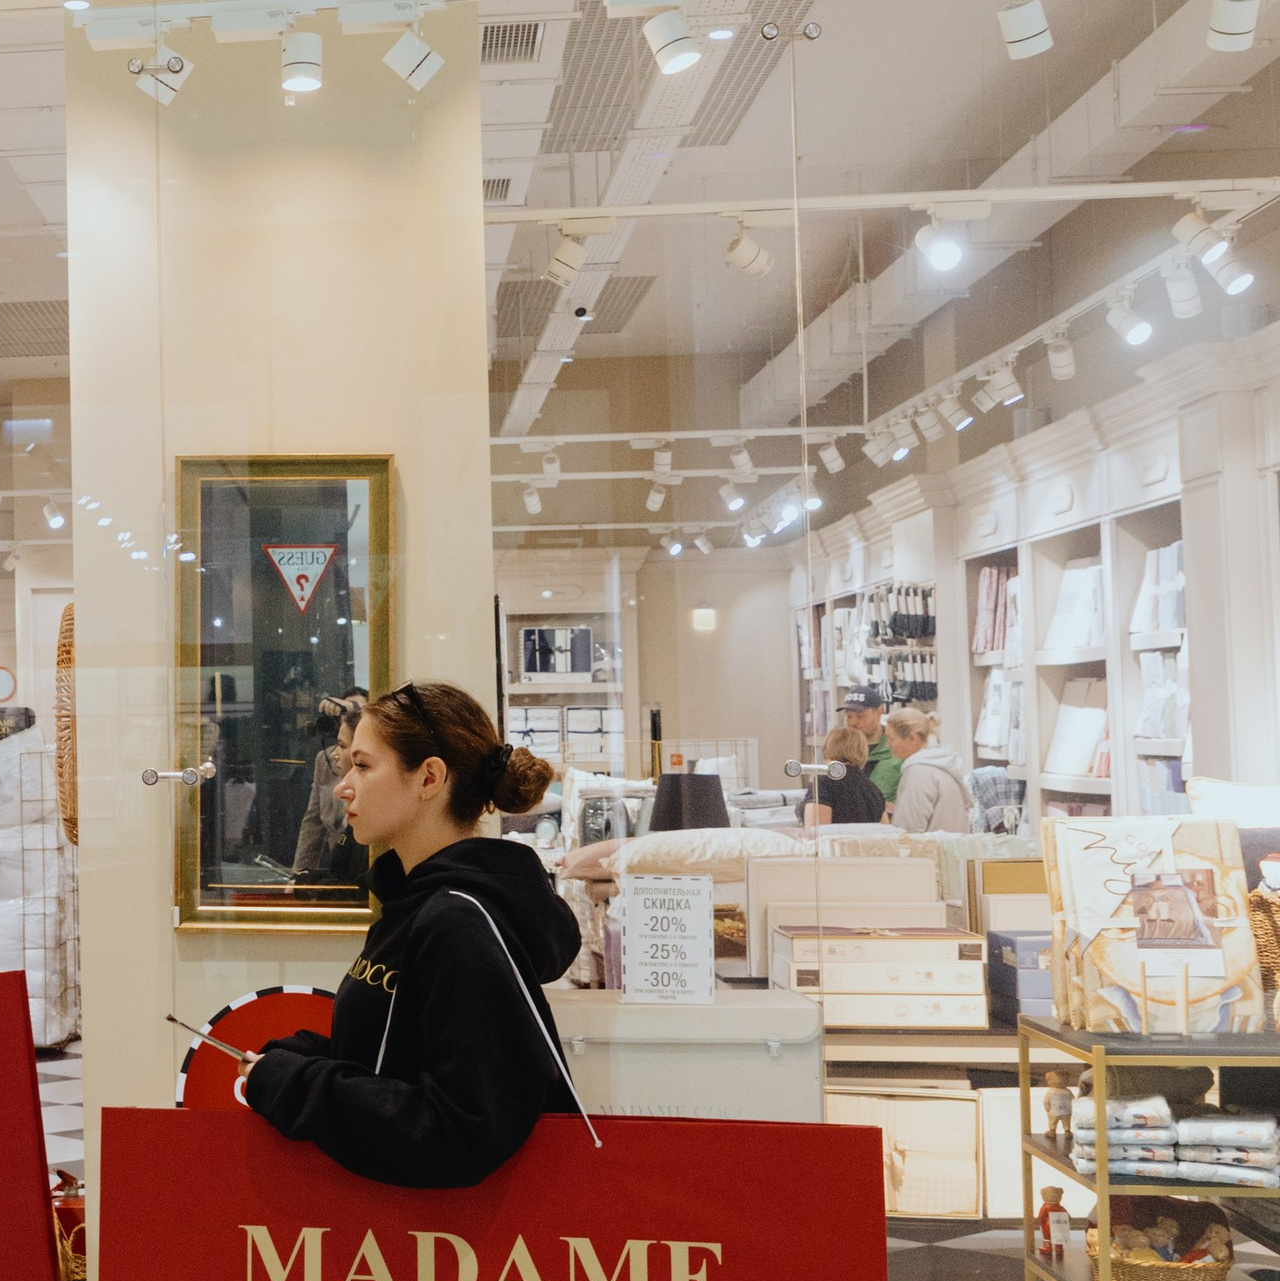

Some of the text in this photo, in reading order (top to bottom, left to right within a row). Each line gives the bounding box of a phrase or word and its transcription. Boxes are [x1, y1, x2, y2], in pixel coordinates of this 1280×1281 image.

[844, 692, 866, 702] OSS
[643, 897, 691, 911] СКИДКА
[644, 916, 686, 932] -20%
[644, 943, 686, 960] -25%
[644, 971, 687, 988] -30%
